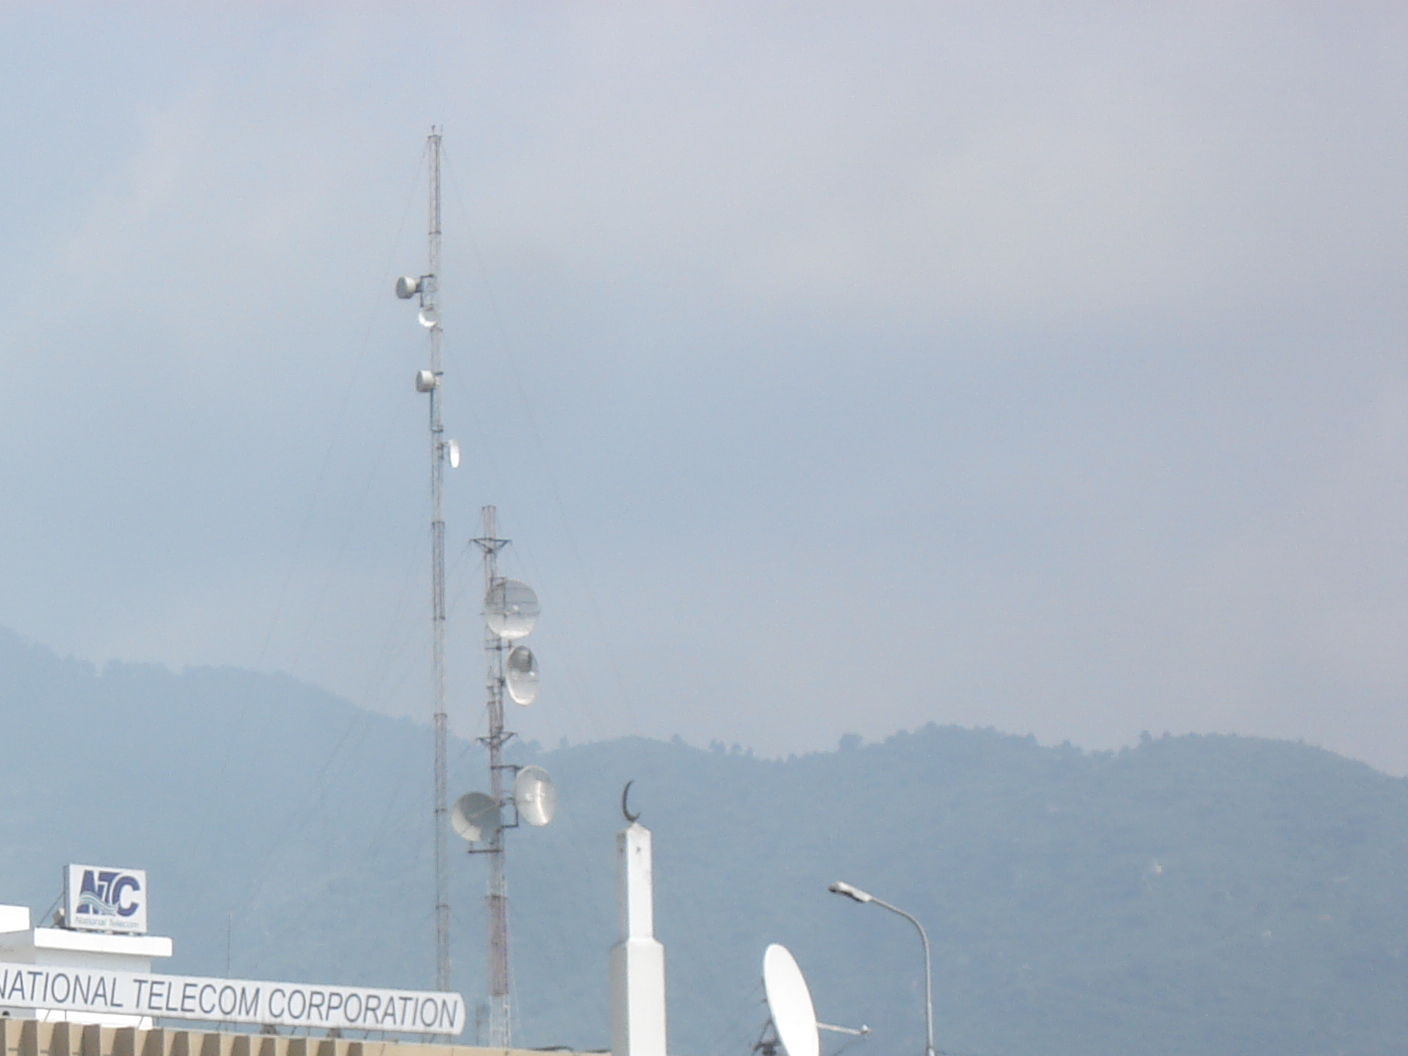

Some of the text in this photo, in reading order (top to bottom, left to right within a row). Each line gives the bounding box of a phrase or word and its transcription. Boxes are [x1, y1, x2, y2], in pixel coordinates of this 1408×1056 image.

[76, 869, 141, 917] NTC
[132, 978, 259, 1017] TELECOM
[268, 989, 457, 1029] CORPORATION
